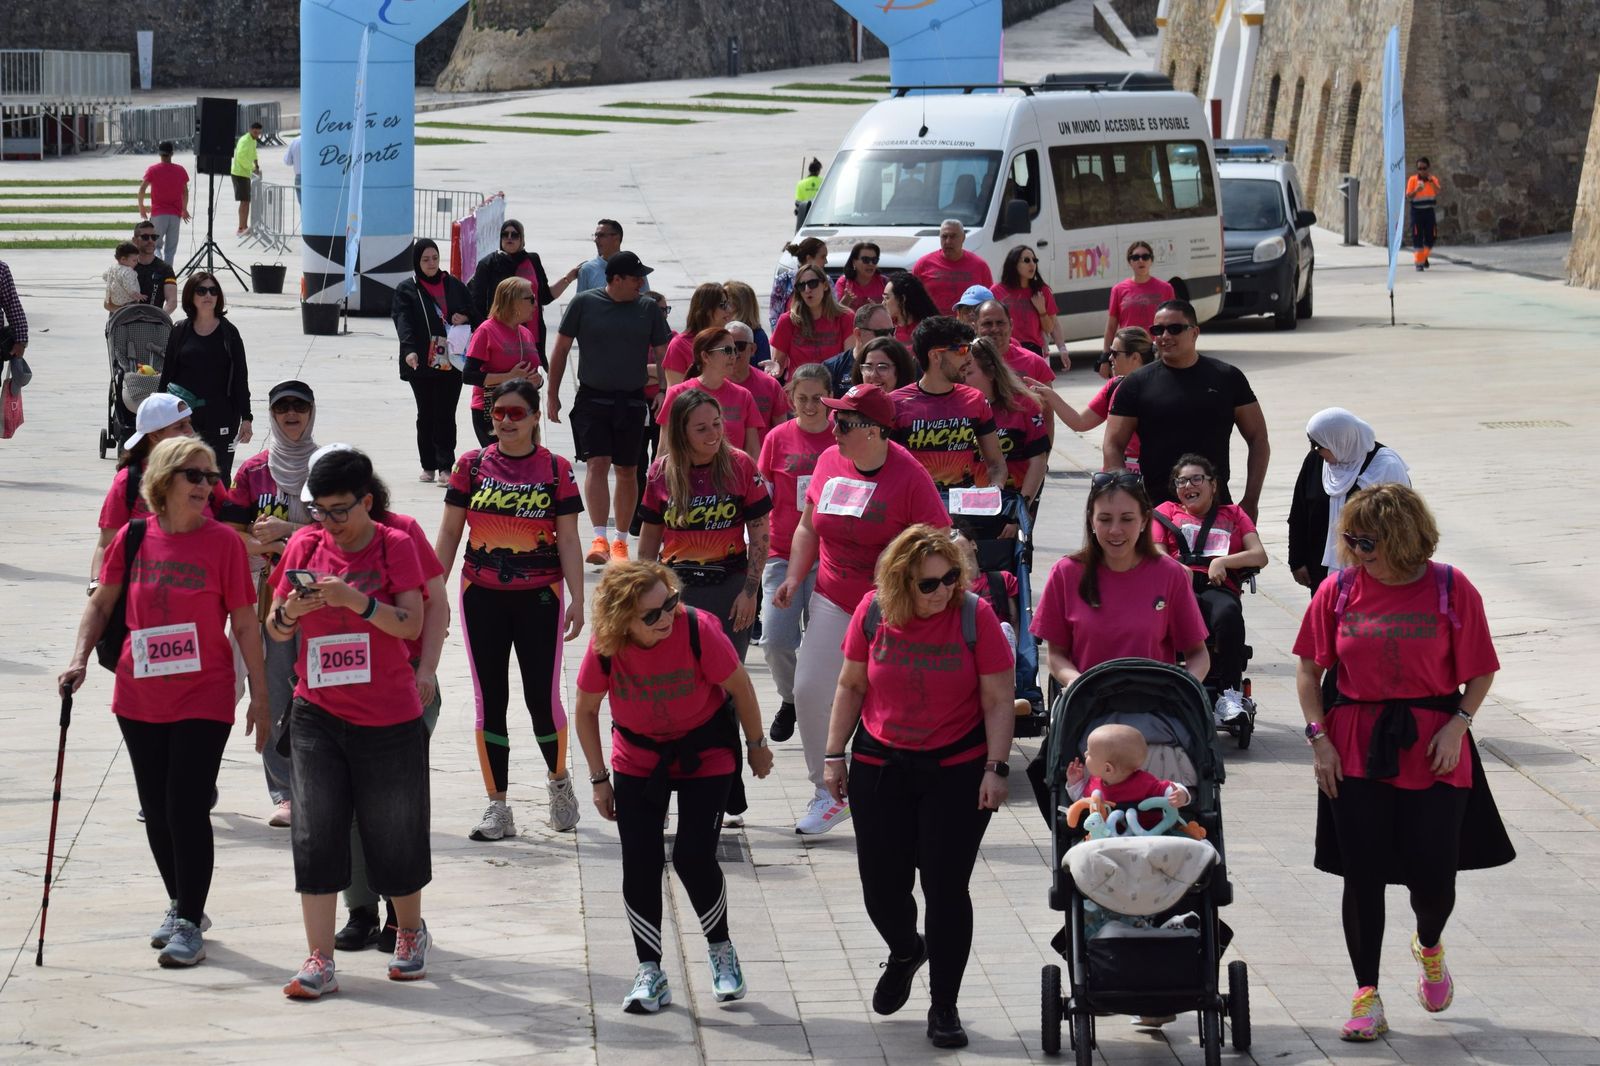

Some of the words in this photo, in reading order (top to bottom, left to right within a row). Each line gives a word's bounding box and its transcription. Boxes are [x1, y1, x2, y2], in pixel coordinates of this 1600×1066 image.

[315, 109, 378, 134] Ceua
[383, 114, 401, 128] es
[1058, 121, 1071, 135] UN
[1071, 119, 1101, 134] MUNDO
[1104, 117, 1146, 133] ACCESIBLE
[1147, 117, 1158, 131] ES
[1159, 116, 1190, 131] POSIBLE
[938, 139, 975, 148] INCLUSIVO
[927, 417, 960, 430] VUELTA
[960, 416, 972, 427] AL
[907, 426, 974, 449] HACHO
[494, 480, 532, 492] VUELTA
[532, 482, 546, 491] AL
[469, 488, 551, 511] HACHO
[515, 507, 546, 518] Ceuta
[705, 519, 732, 530] Ceuta
[149, 639, 194, 659] 2064
[321, 649, 366, 669] 2065
